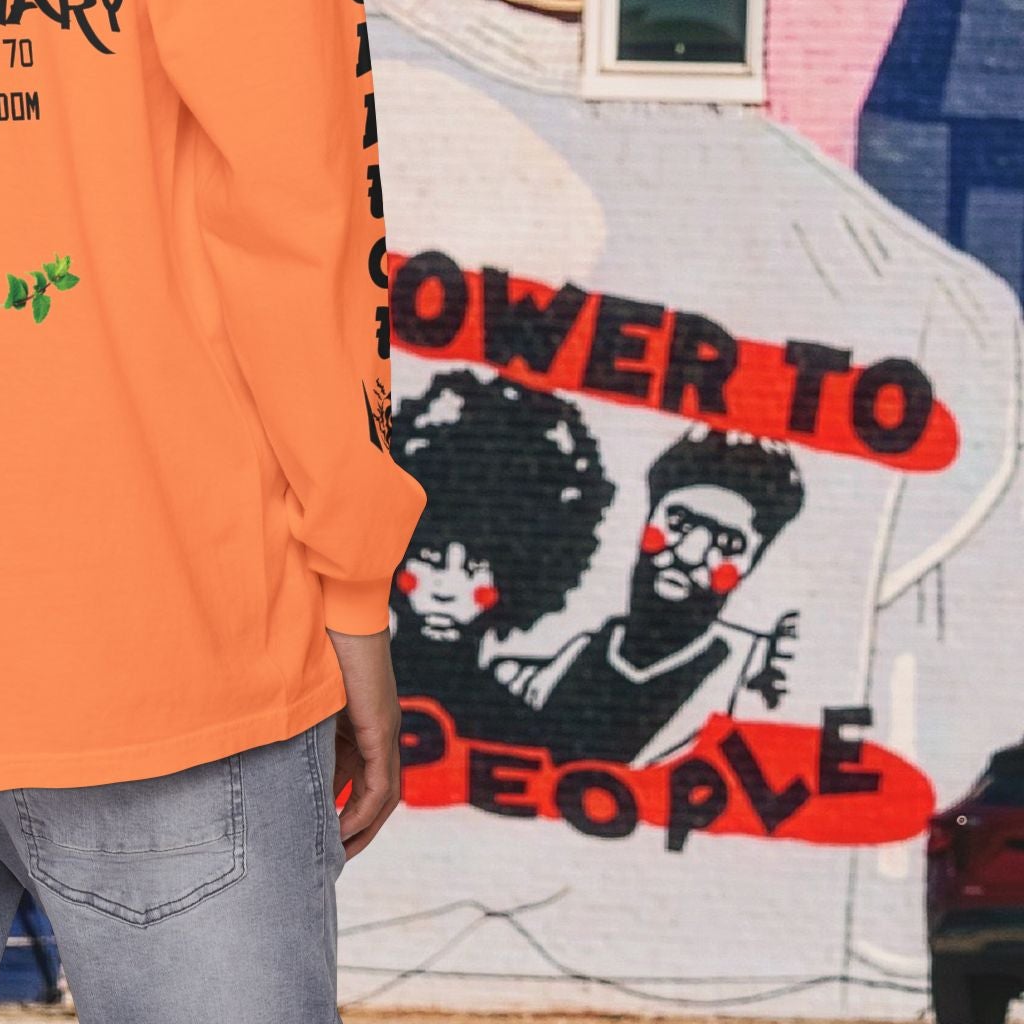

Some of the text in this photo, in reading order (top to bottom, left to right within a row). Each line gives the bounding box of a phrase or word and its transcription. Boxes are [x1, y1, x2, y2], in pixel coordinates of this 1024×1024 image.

[3, 39, 33, 68] 70
[390, 250, 934, 455] OWER TO
